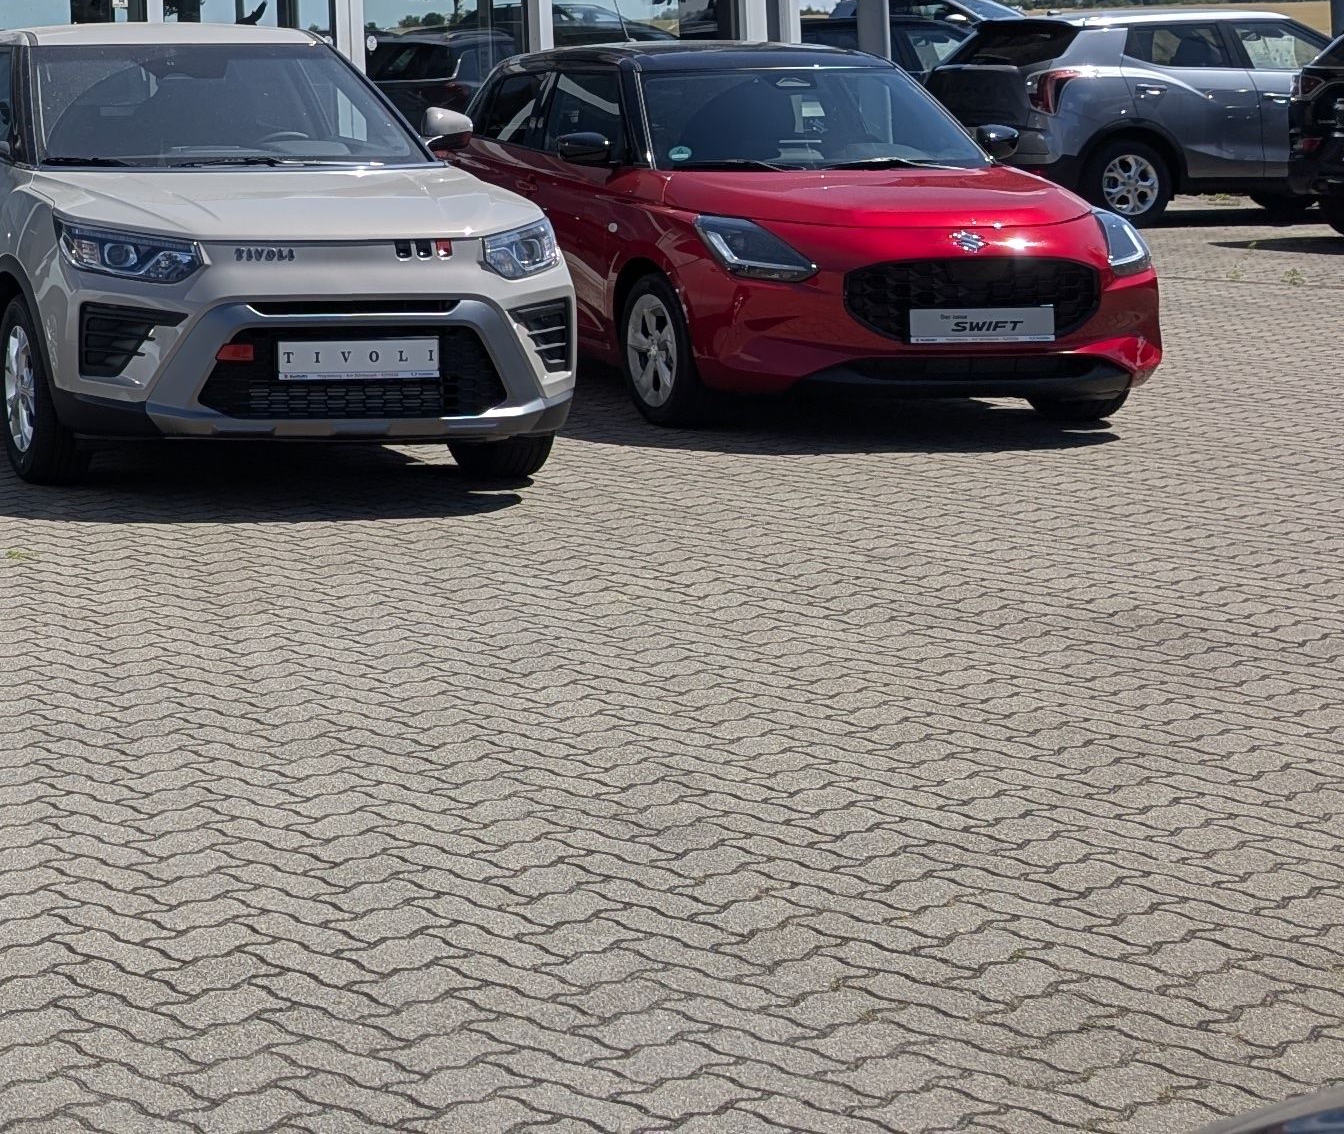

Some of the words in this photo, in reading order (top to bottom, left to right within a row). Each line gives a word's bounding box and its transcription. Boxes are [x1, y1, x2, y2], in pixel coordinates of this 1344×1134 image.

[234, 247, 295, 262] TIVOLI
[951, 320, 1024, 333] SWIFT
[283, 350, 434, 364] TIVOLI
